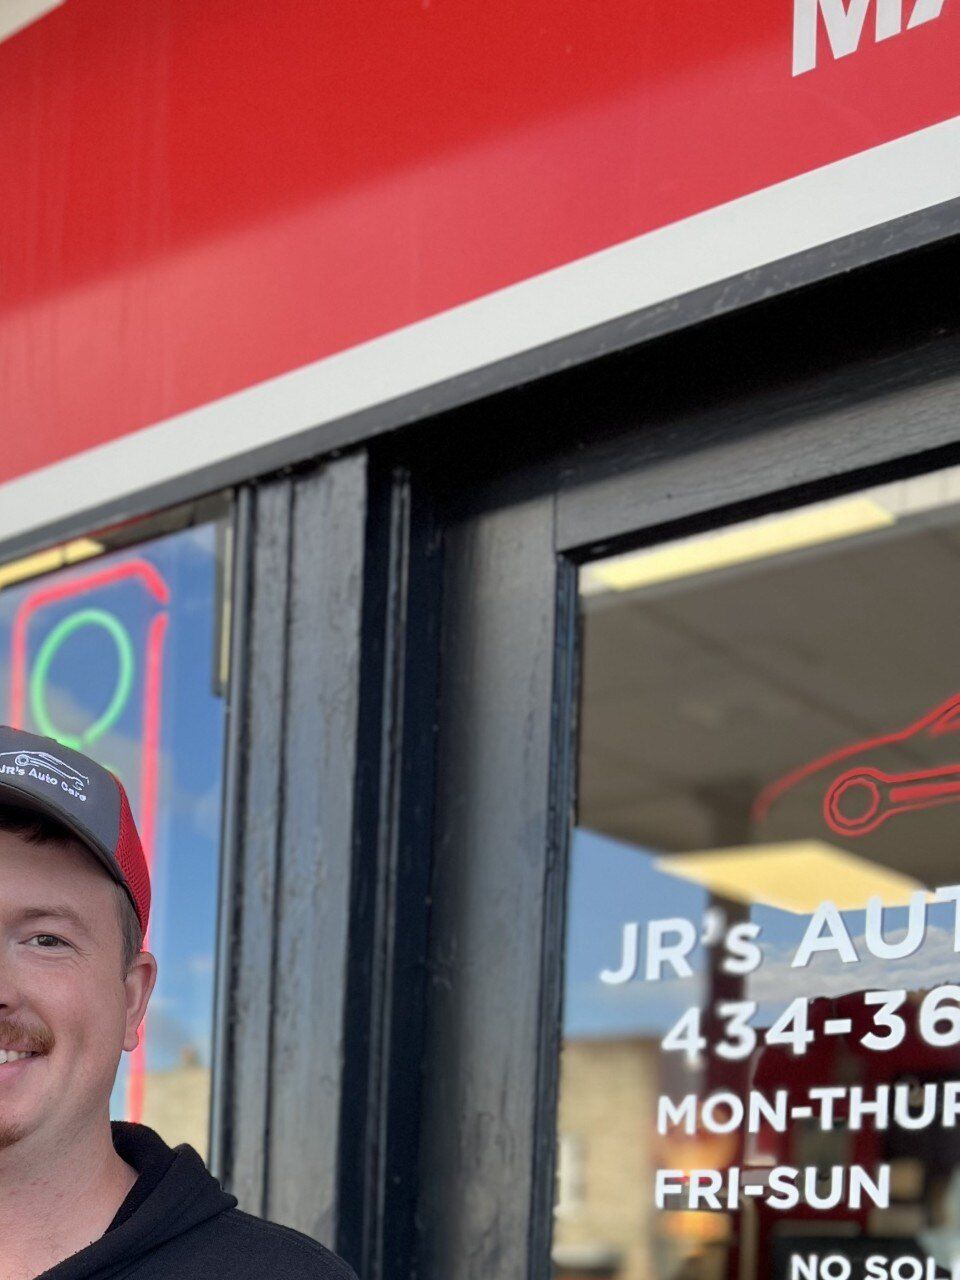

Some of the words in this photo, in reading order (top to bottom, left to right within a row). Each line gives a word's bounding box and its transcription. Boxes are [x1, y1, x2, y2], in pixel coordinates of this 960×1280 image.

[28, 768, 58, 785] Auto
[61, 781, 87, 802] Care
[599, 912, 763, 984] JR's
[661, 985, 960, 1065] 434-36
[655, 1164, 891, 1211] FRI-SUN
